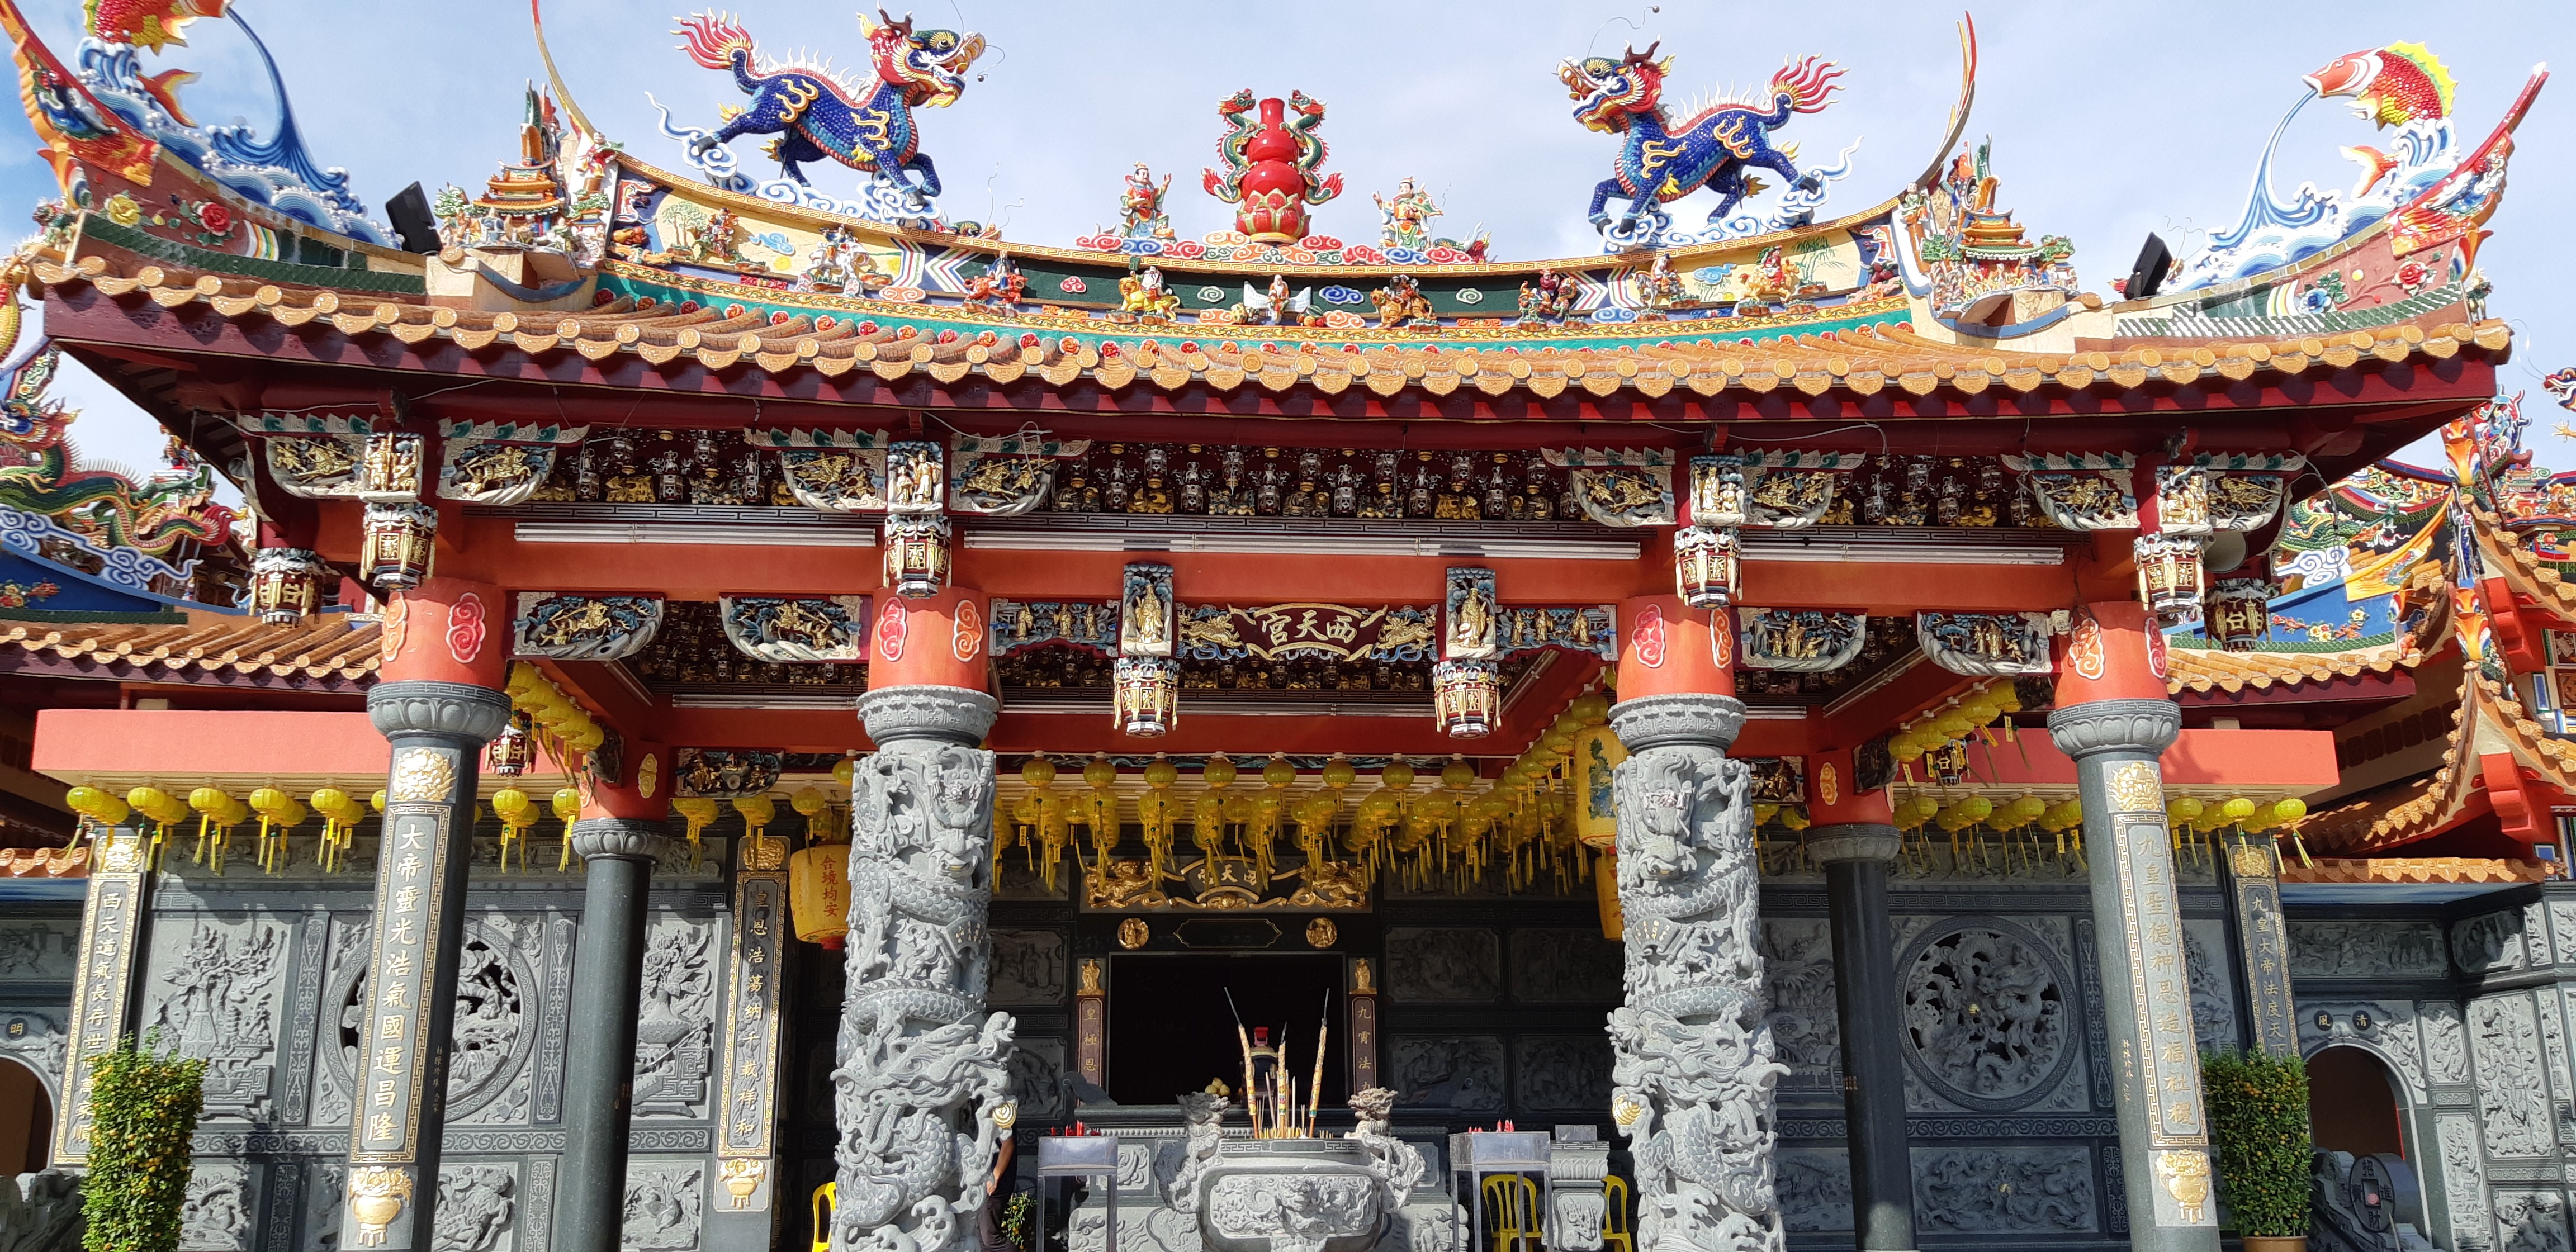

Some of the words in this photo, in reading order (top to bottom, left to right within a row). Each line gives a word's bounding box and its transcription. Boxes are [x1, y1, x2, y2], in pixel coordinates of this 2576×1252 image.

[1262, 610, 1357, 646] 西天宮
[820, 854, 840, 917] 合境均安
[367, 823, 427, 1142] 大帝靈光浩氣國運昌隆
[2136, 834, 2196, 1126] 九皇聖德神恩造福社稷
[10, 1022, 23, 1035] 明
[735, 891, 769, 1136] 皇恩浩蕩納千載祥和
[1083, 1007, 1097, 1071] 皇極恩
